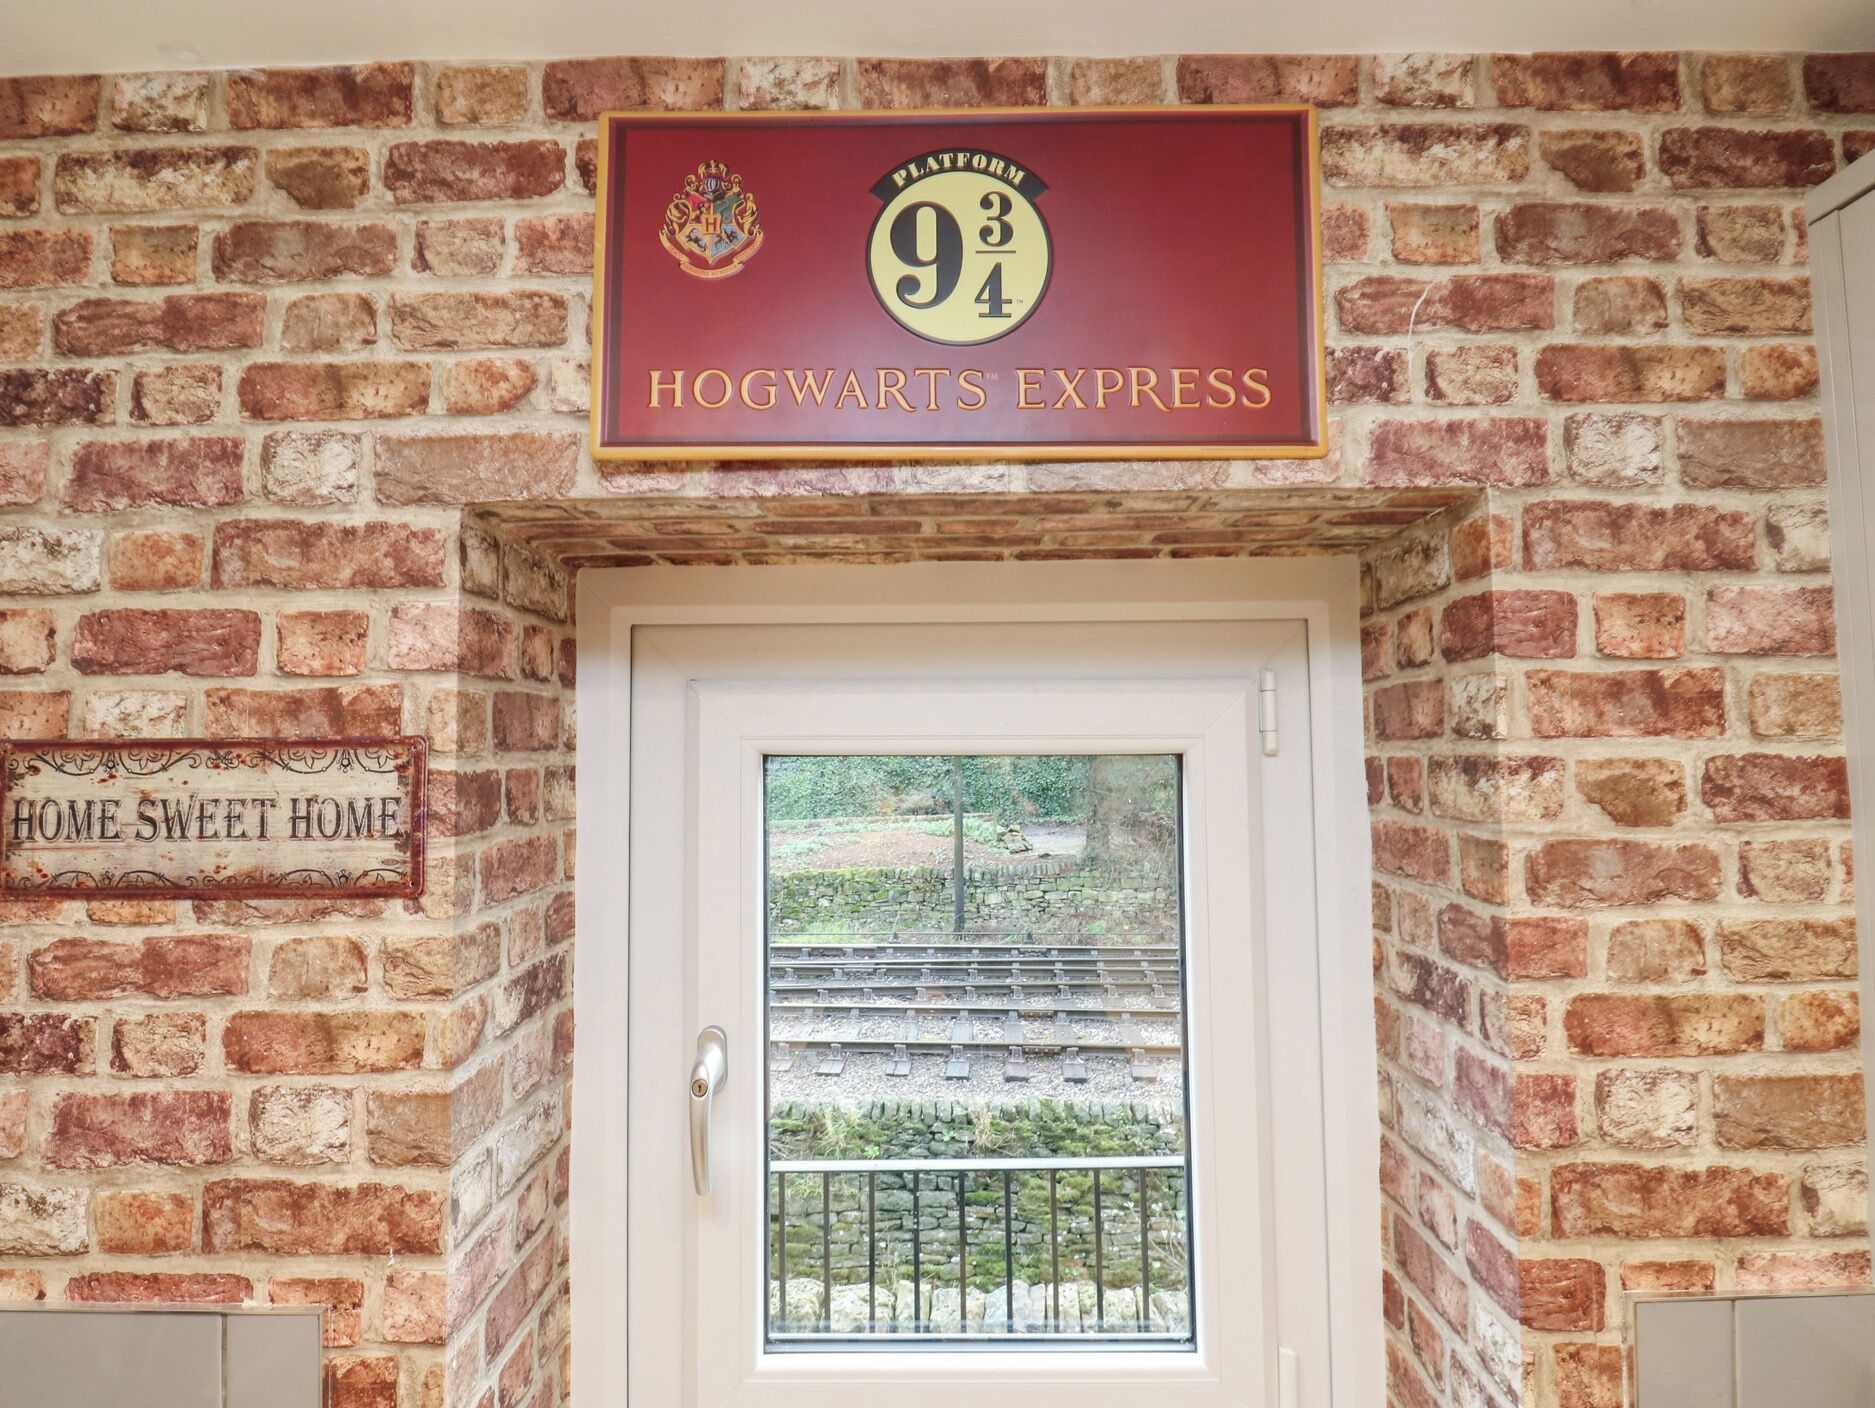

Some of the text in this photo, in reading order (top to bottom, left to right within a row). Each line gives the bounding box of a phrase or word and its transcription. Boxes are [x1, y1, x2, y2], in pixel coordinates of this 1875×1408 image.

[892, 152, 1027, 188] PLATFORM
[648, 368, 987, 412] HOGWARTS
[1016, 367, 1272, 412] EXPRESS
[11, 795, 403, 842] HOME SWEET HOME
